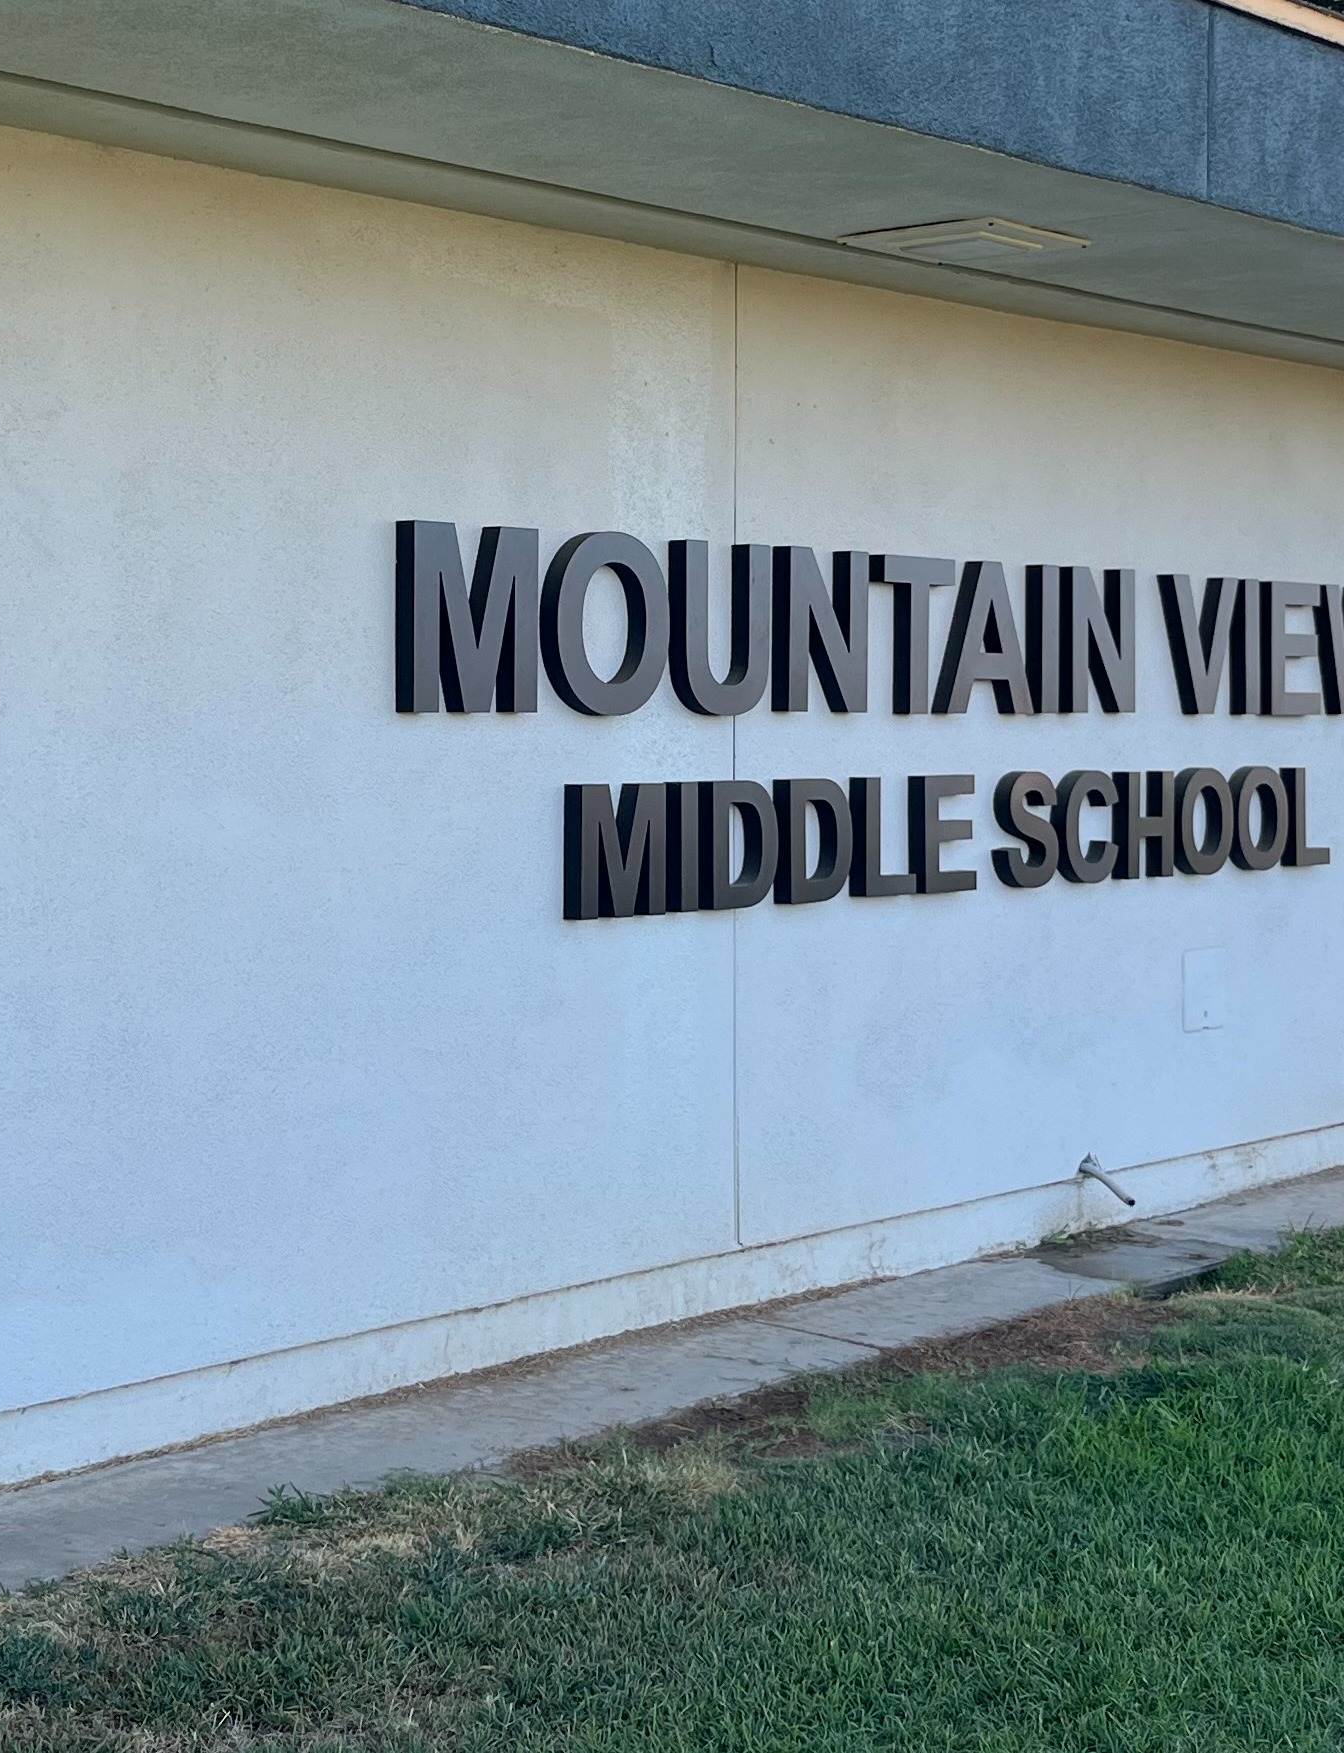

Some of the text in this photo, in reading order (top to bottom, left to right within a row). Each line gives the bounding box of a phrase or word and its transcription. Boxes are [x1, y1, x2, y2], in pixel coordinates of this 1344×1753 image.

[395, 519, 1136, 716] MOUNTAIN
[563, 766, 1330, 920] MIDDLE SCHOOL
